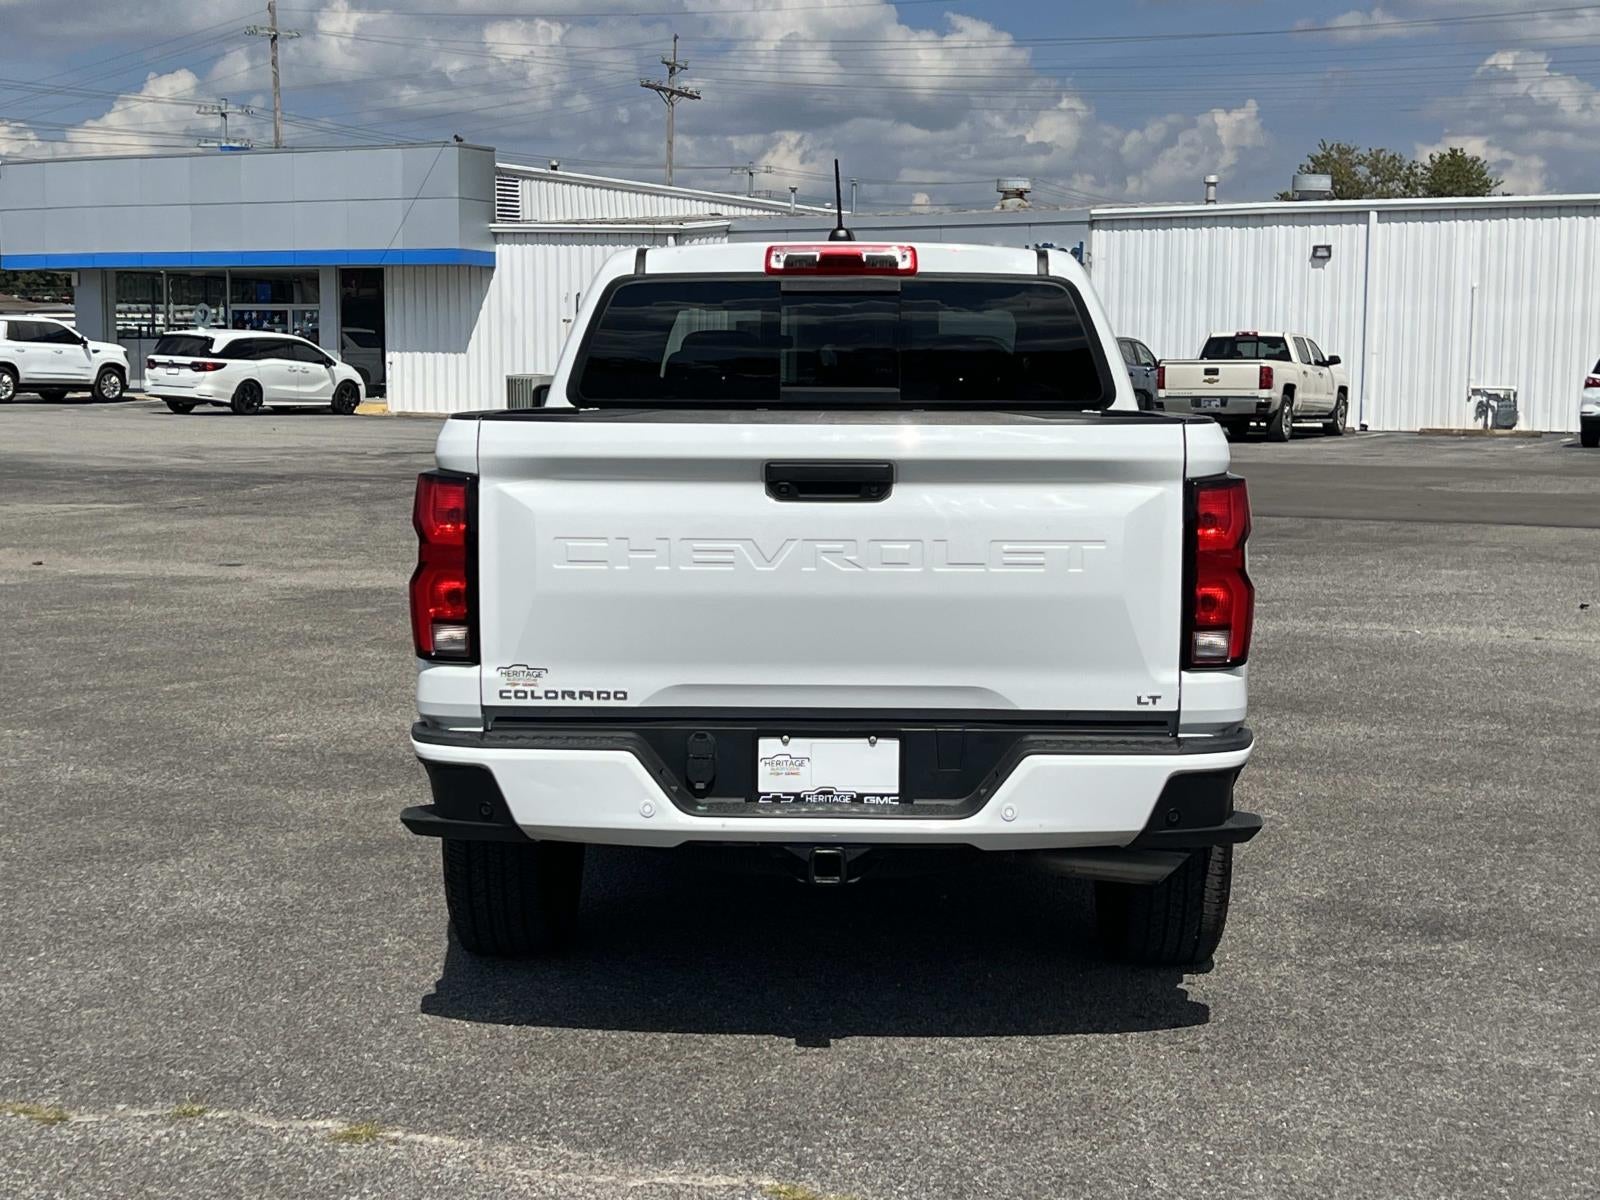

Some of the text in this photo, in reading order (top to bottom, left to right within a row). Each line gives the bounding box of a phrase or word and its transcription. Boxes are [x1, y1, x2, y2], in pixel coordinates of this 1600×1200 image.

[552, 536, 1107, 573] CHEVROLET
[500, 670, 543, 678] HERITAGE
[499, 689, 628, 701] COLORADO
[1136, 695, 1162, 706] LT
[764, 759, 806, 767] HERITAGE
[805, 794, 900, 805] HERITAGE GMC
